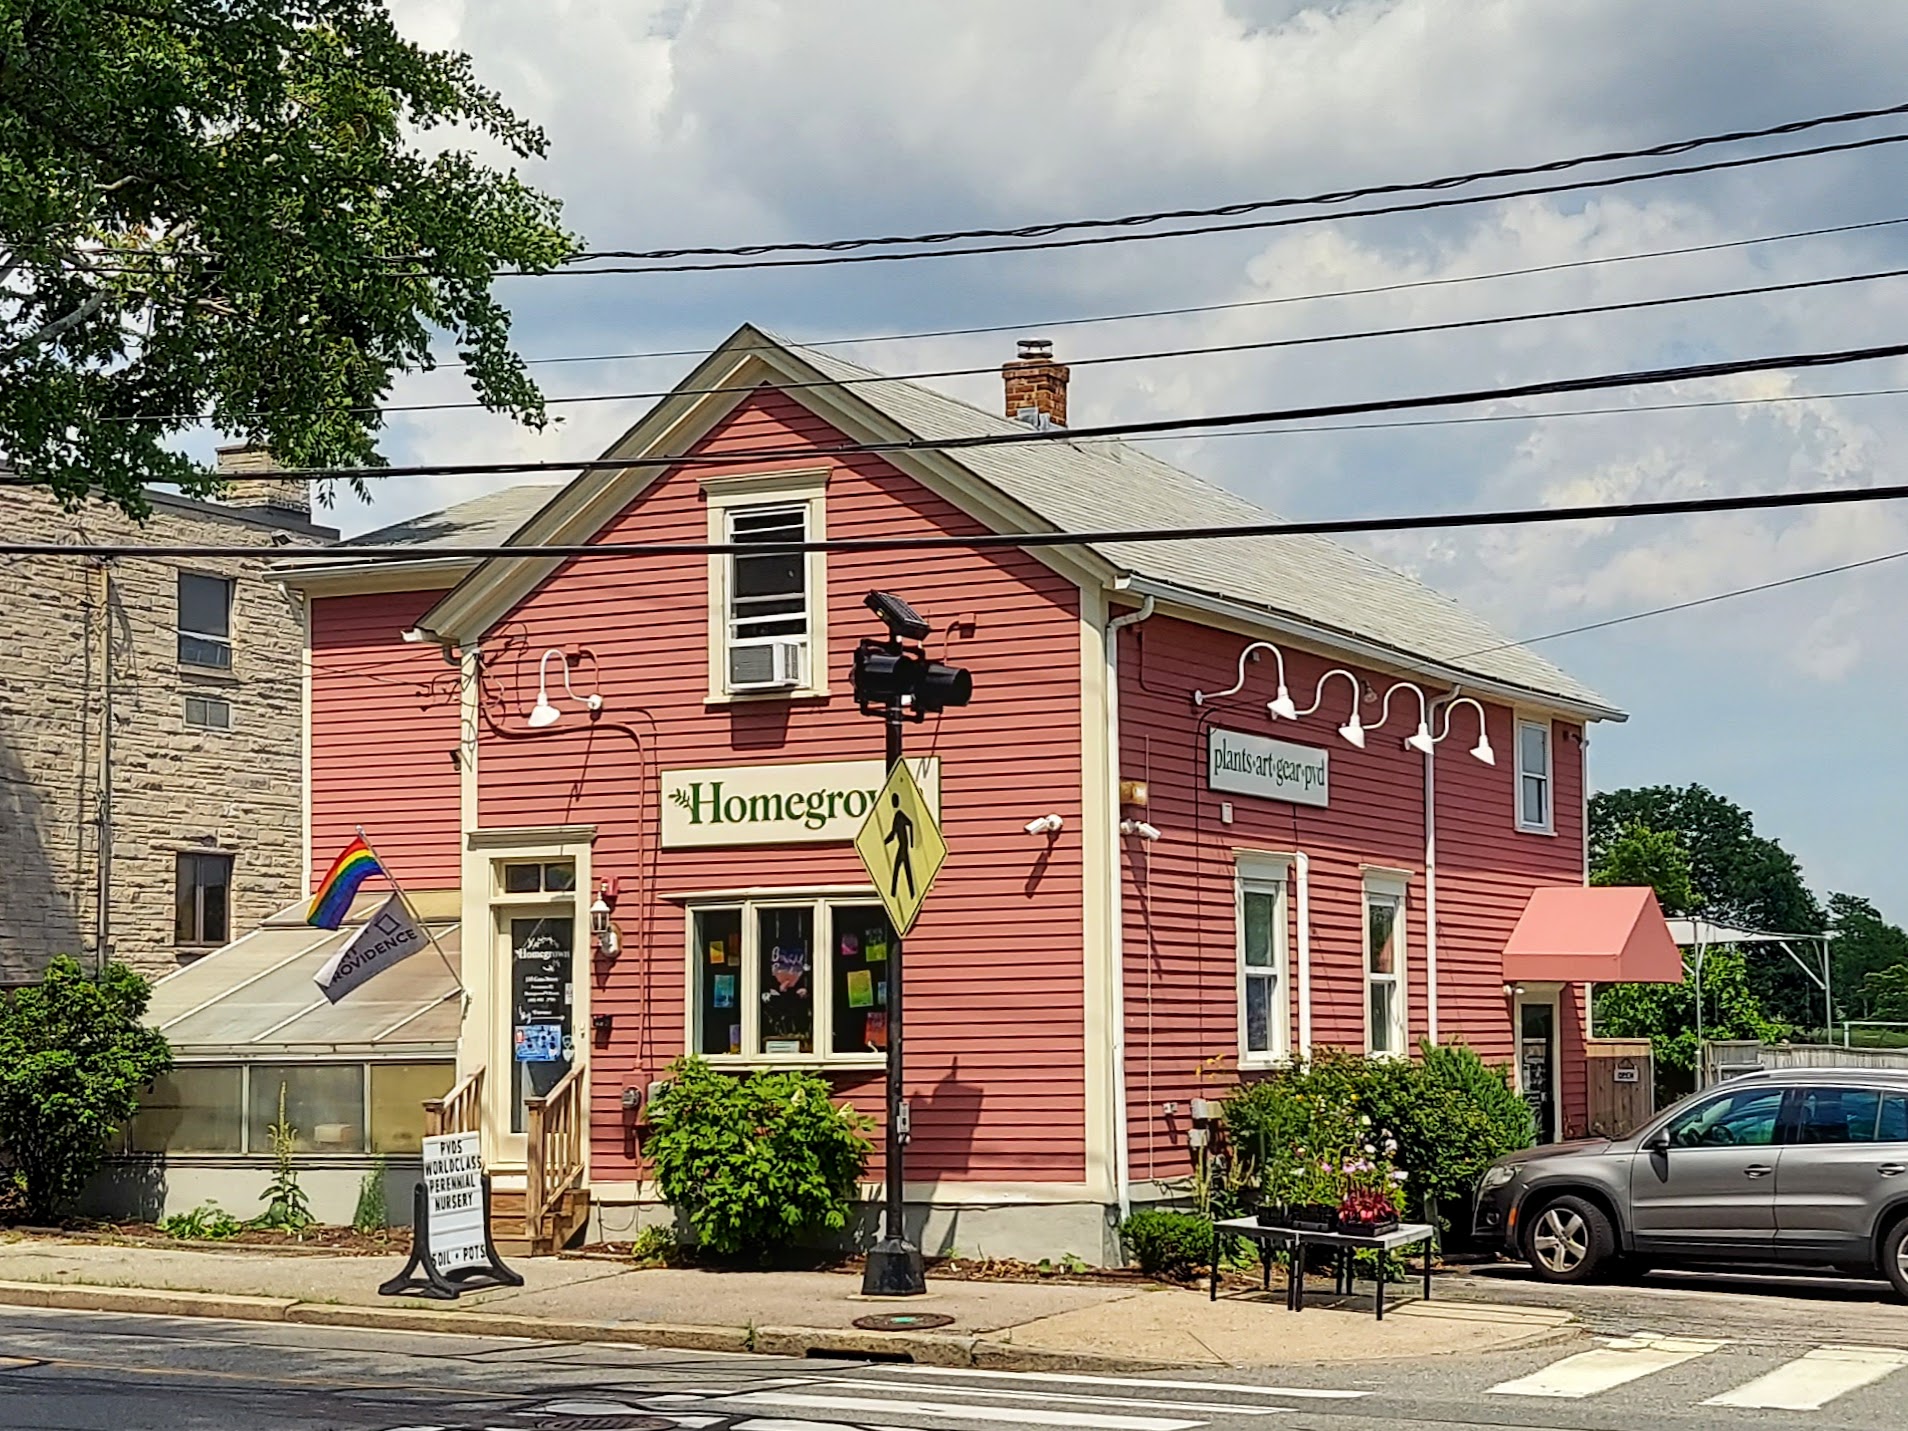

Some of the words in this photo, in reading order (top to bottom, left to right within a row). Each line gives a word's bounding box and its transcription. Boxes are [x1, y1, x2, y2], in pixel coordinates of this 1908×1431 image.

[688, 781, 878, 830] Homegro
[332, 928, 418, 983] ROVIDENCE
[440, 1139, 463, 1156] PVDS
[425, 1155, 482, 1176] WORLDCLASS
[429, 1174, 476, 1194] PERENNIAL
[434, 1192, 474, 1212] NURSERY
[431, 1250, 451, 1268] SOIL
[463, 1244, 486, 1262] POTS
